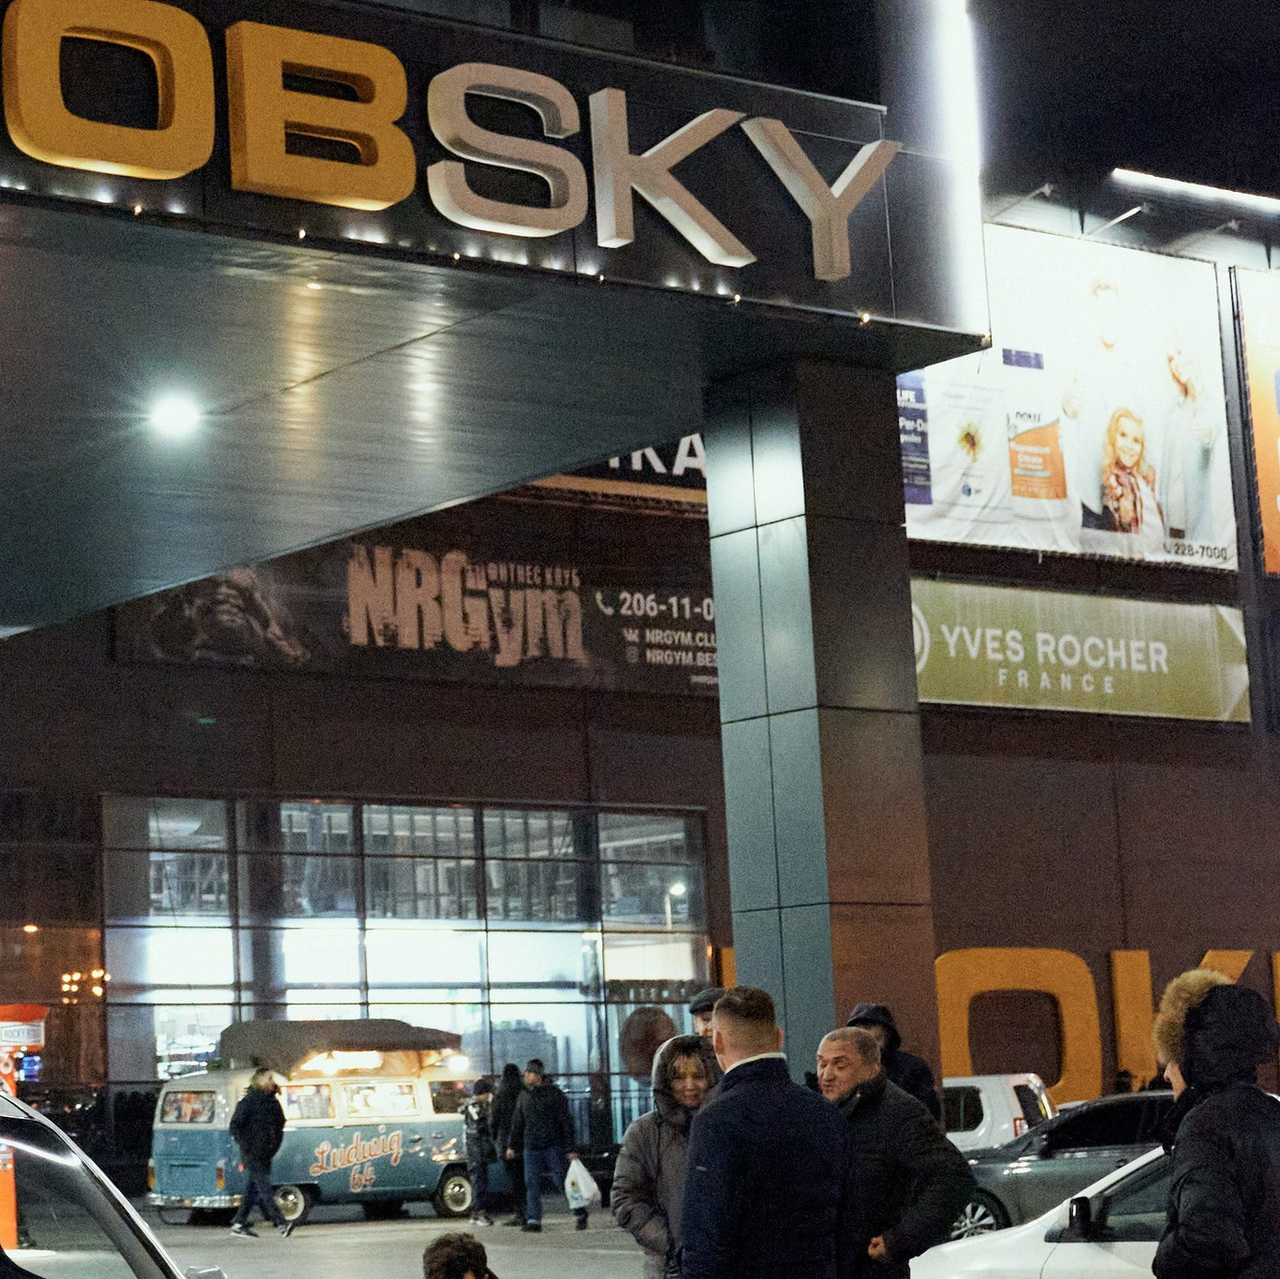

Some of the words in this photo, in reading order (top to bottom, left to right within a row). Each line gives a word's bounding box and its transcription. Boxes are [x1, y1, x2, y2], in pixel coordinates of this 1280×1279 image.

[940, 623, 1026, 664] YVES
[1036, 630, 1169, 674] ROCHER
[997, 668, 1115, 696] FRANCE
[309, 1124, 403, 1177] Ludwig
